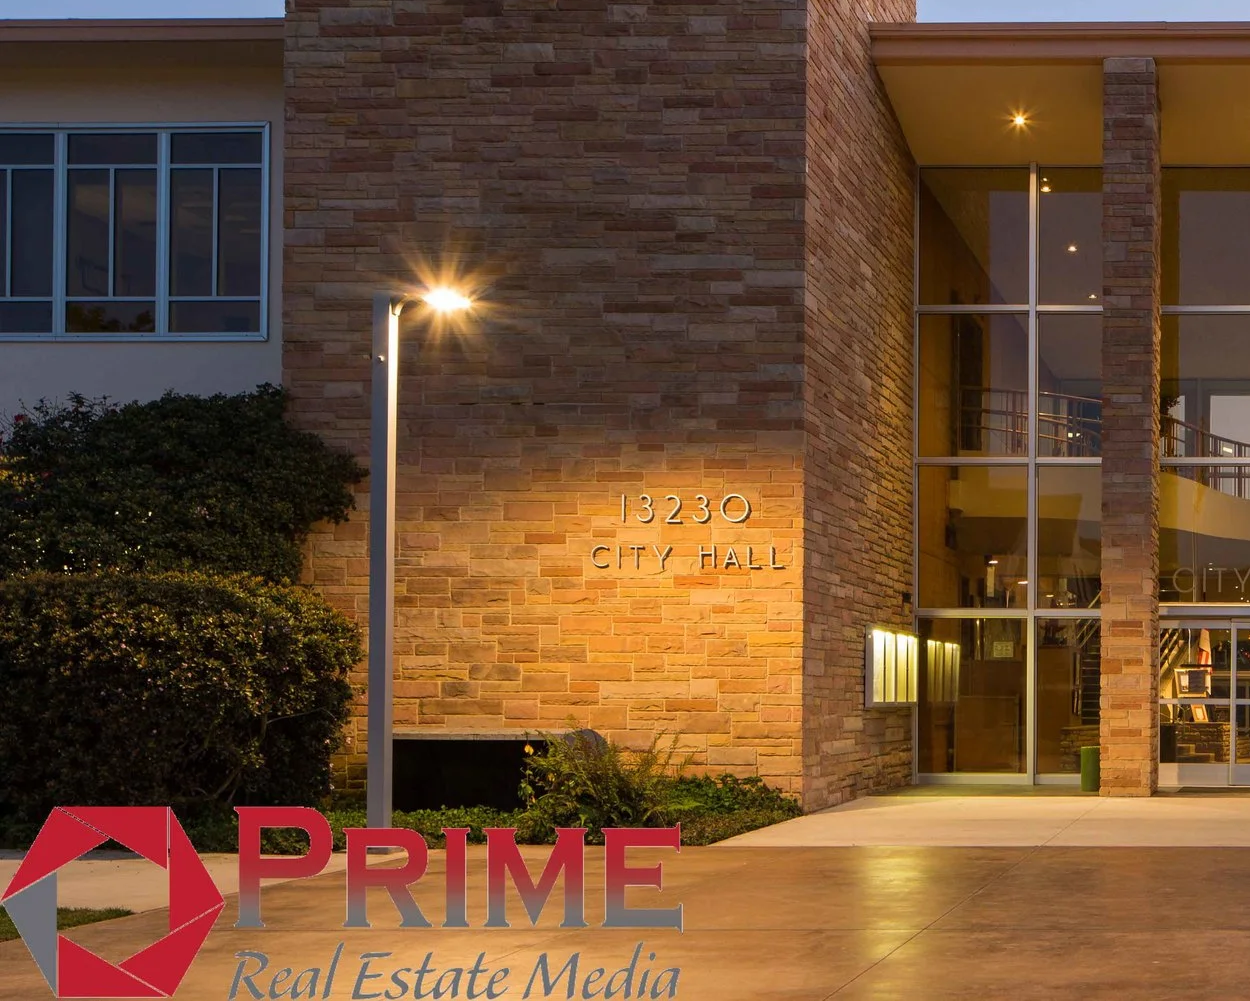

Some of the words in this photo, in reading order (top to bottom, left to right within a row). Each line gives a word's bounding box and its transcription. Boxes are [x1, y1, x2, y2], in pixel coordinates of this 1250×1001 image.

[621, 494, 750, 523] 13230
[591, 544, 673, 570] CITY
[698, 544, 786, 570] HALL
